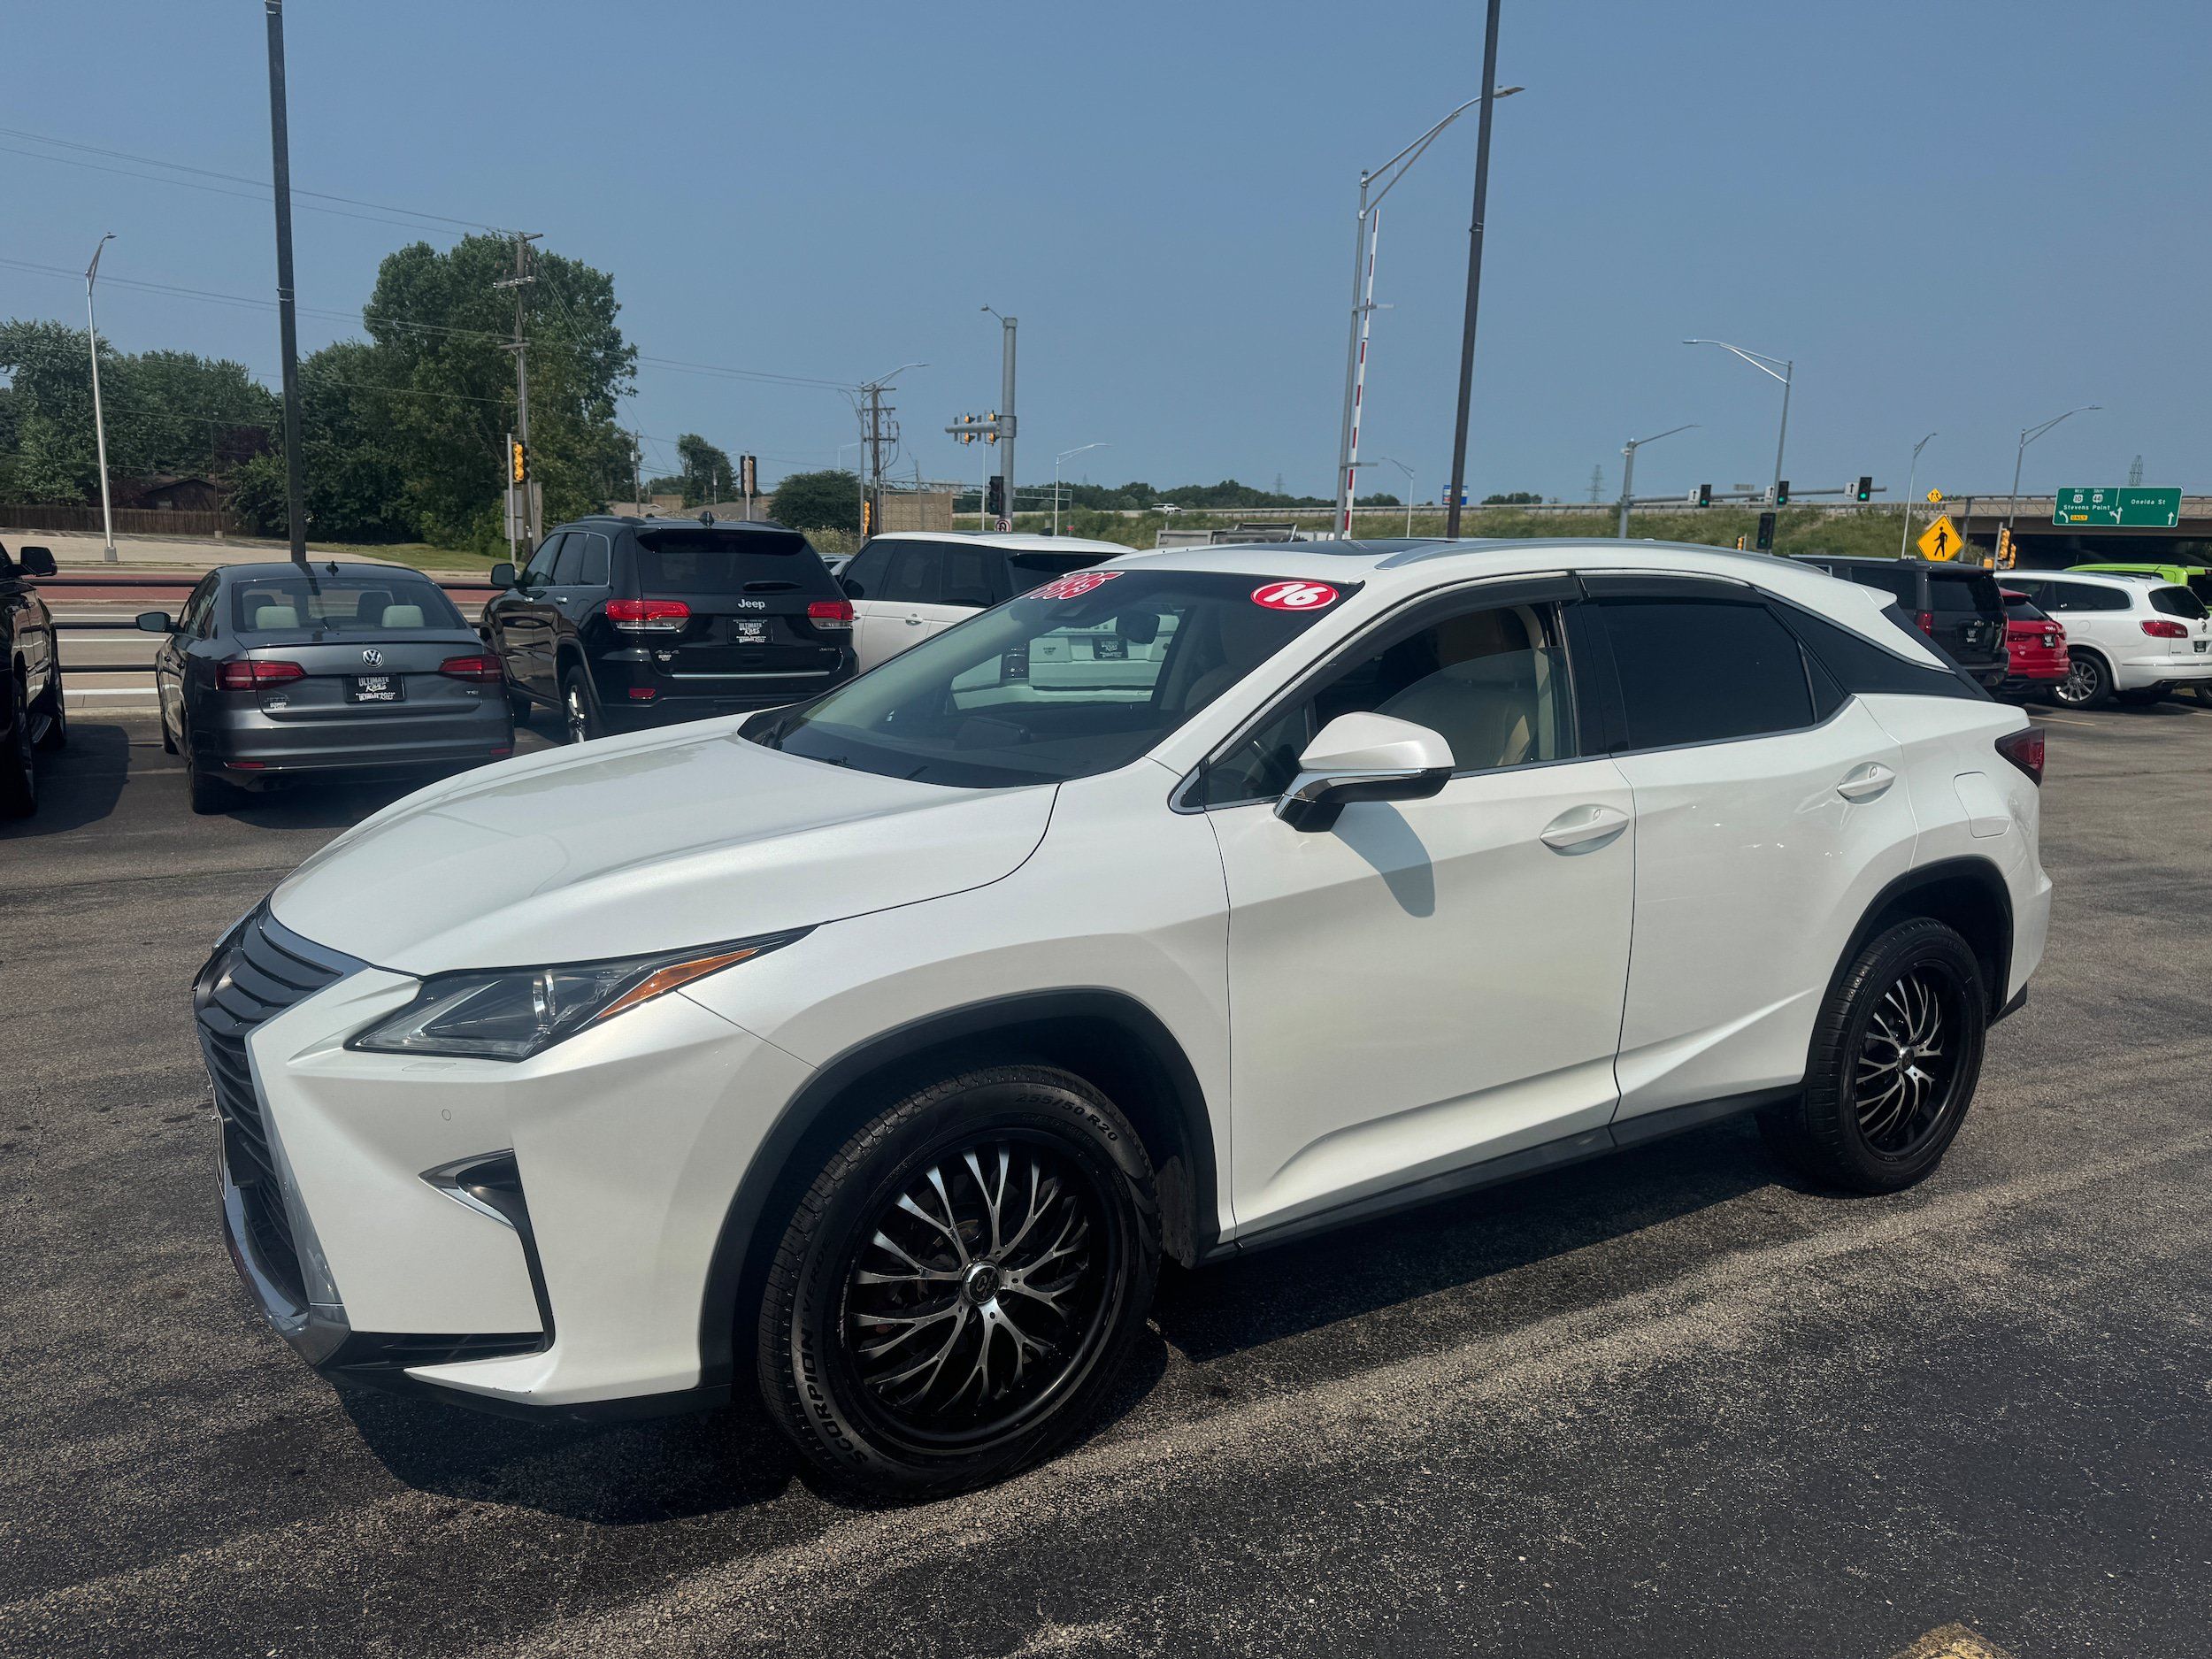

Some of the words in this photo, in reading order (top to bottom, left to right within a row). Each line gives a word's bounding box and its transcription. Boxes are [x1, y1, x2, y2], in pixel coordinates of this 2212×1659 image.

[1263, 583, 1329, 606] 16
[737, 598, 766, 611] Jeep
[739, 622, 763, 631] ULTIMATE
[358, 676, 390, 687] ULTIMATE
[1015, 1093, 1086, 1116] 255/50
[1087, 1113, 1119, 1141] R20
[800, 1328, 869, 1465] SCORPION
